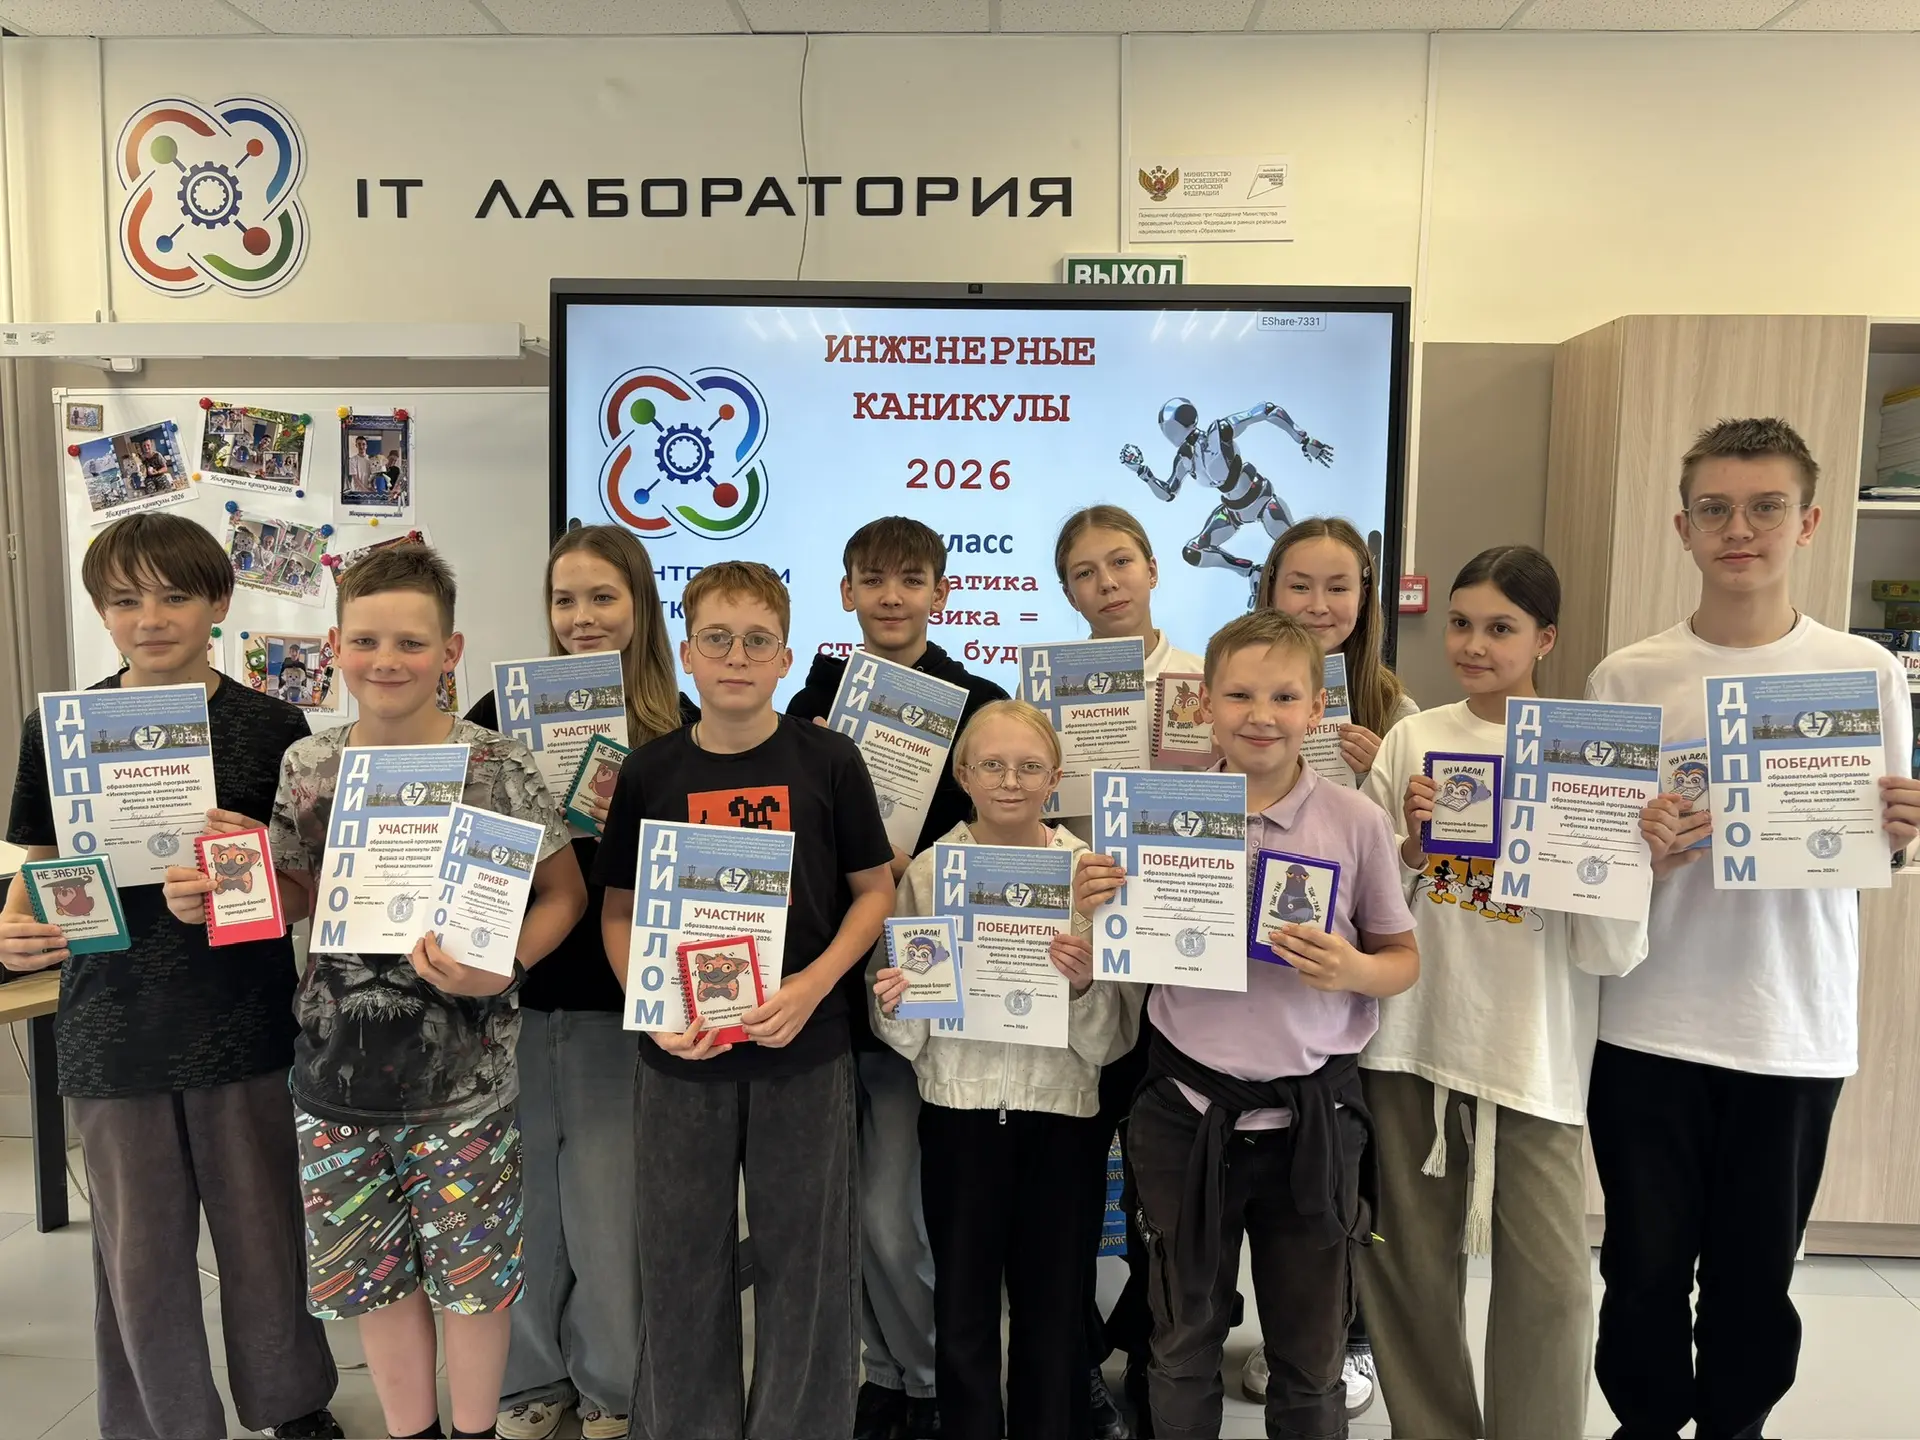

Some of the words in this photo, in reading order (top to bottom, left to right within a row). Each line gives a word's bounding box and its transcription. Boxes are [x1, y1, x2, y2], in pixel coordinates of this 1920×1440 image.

[357, 178, 423, 219] IT
[474, 176, 1072, 220] ЛАБОРАТОРИЯ
[1075, 264, 1177, 284] ВЫХОД
[1262, 318, 1320, 326] EShare-7331
[825, 335, 1095, 365] ИНЖЕНЕРНЫЕ
[853, 393, 1070, 421] КАНИКУЛЫ
[907, 459, 1011, 490] 2026
[248, 482, 276, 491] каникулы
[142, 498, 170, 508] каникулы
[171, 493, 184, 501] 2026
[939, 534, 1013, 553] ласс
[949, 575, 1038, 591] атика
[928, 610, 1000, 626] зика
[964, 639, 1018, 664] буд
[1093, 673, 1108, 693] 17
[1071, 707, 1129, 719] УЧАСТНИК
[553, 724, 611, 737] УЧАСТНИК
[1807, 712, 1829, 736] 17
[142, 726, 162, 748] 17
[874, 730, 931, 757] УЧАСТНИК
[597, 745, 608, 753] НЕ
[1592, 741, 1611, 766] 17
[1766, 755, 1871, 770] ПОБЕДИТЕЛЬ
[56, 699, 96, 854] ДИПЛО
[113, 764, 190, 779] УЧАСТНИК
[107, 781, 162, 790] образовательной
[1717, 682, 1756, 882] ДИПЛОМ
[407, 783, 424, 804] 17
[1552, 782, 1646, 800] ПОБЕДИТЕЛЬ
[1502, 704, 1542, 898] ДИПЛОМ
[1552, 797, 1605, 806] образовательной
[378, 823, 438, 834] УЧАСТНИК
[1181, 812, 1200, 836] 17
[1596, 818, 1628, 826] страницах
[320, 754, 371, 946] ДИПЛОМ
[1143, 854, 1234, 870] ПОБЕДИТЕЛЬ
[36, 871, 51, 880] НЕ
[52, 867, 95, 878] ЗАБУДЬ
[478, 872, 509, 886] ПРИЗЕР
[726, 868, 746, 891] 17
[1144, 870, 1196, 878] образовательной
[474, 884, 508, 897] ОЛИМПИАДЫ
[1012, 884, 1030, 906] 17
[694, 908, 765, 923] УЧАСТНИК
[635, 829, 678, 1025] ДИПЛОМ
[685, 922, 736, 931] образовательной
[977, 922, 1060, 936] ПОБЕДИТЕЛЬ
[978, 936, 1025, 944] образовательной
[700, 1008, 731, 1016] Склерозный
